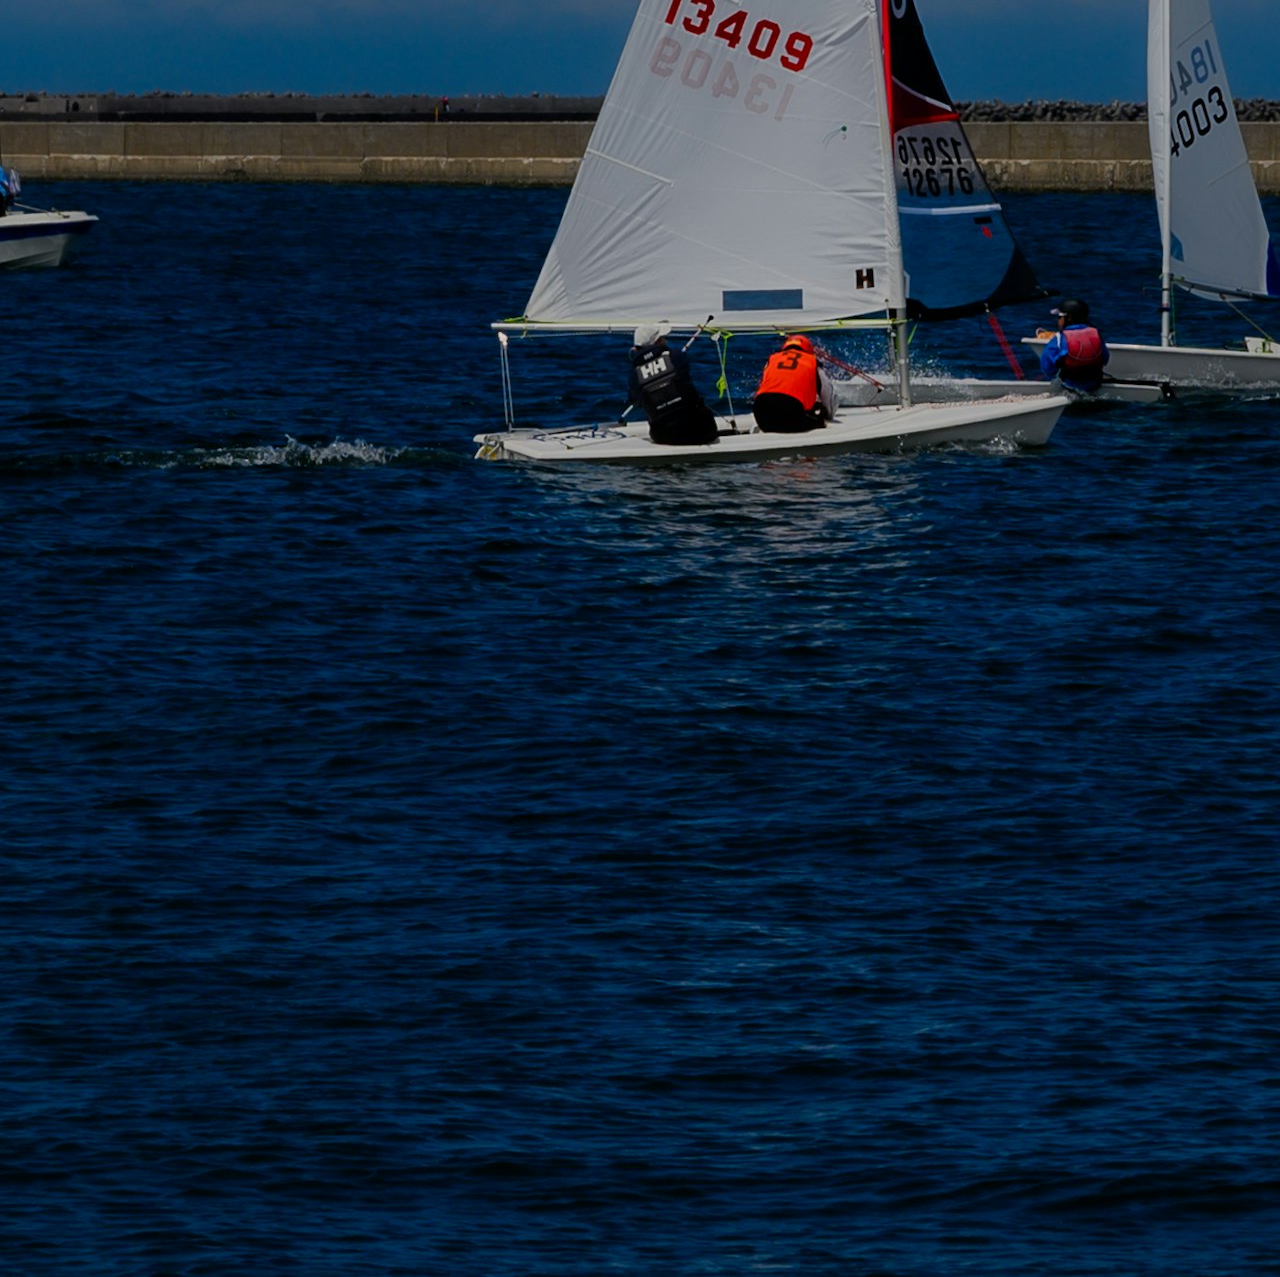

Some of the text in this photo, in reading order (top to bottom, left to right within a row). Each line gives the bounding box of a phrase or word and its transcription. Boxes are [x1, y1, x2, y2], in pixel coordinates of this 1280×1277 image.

[903, 168, 973, 197] 12676
[856, 268, 875, 289] H
[640, 357, 668, 380] HH
[777, 351, 802, 370] 3
